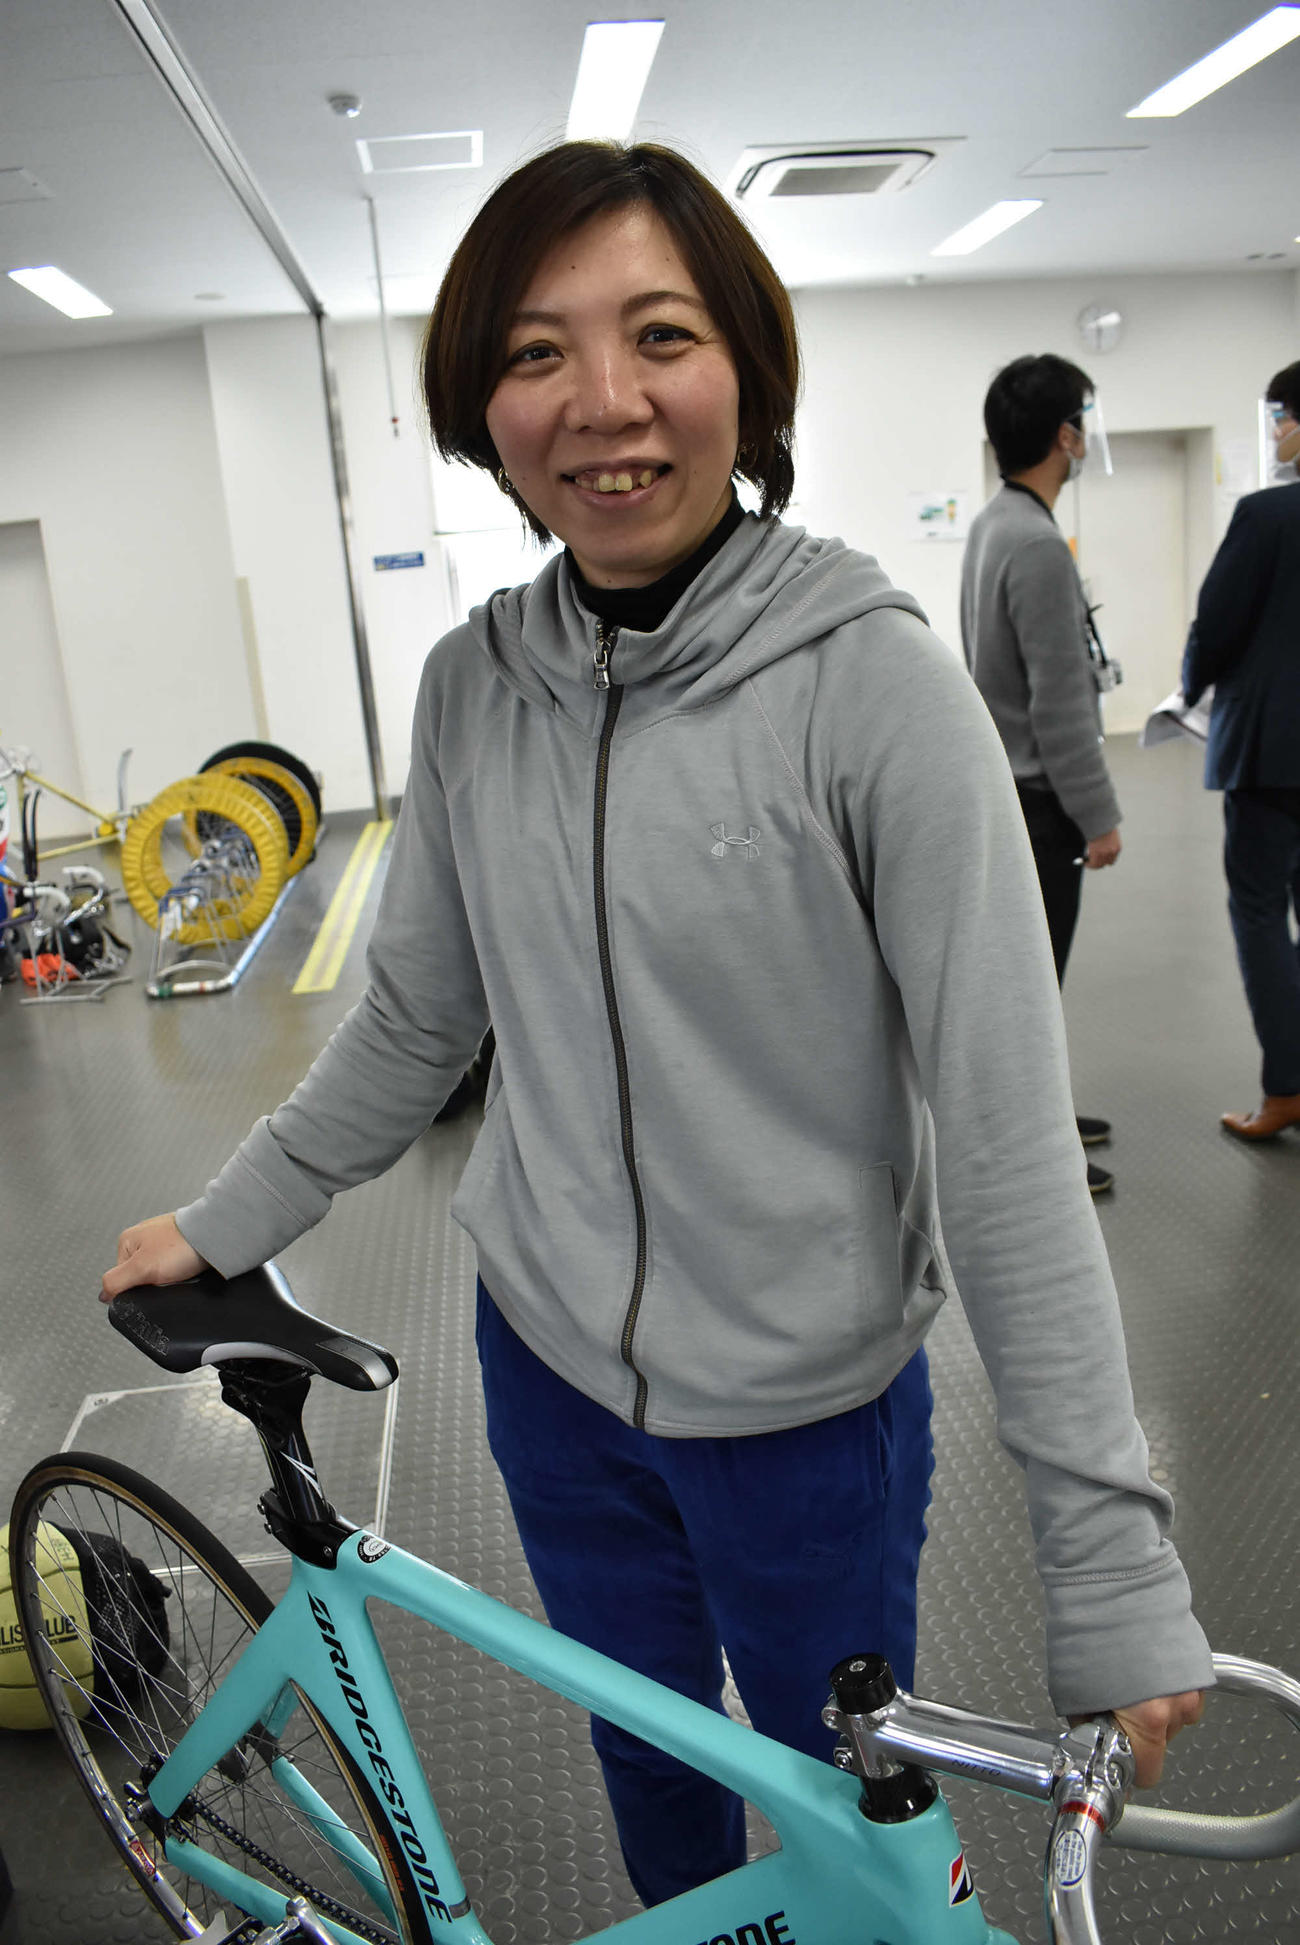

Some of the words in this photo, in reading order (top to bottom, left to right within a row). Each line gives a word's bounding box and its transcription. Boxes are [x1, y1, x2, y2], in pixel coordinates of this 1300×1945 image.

[0, 1624, 24, 1646] LIS
[45, 1615, 76, 1637] LUB
[307, 1590, 452, 1923] BRIDGESTONE
